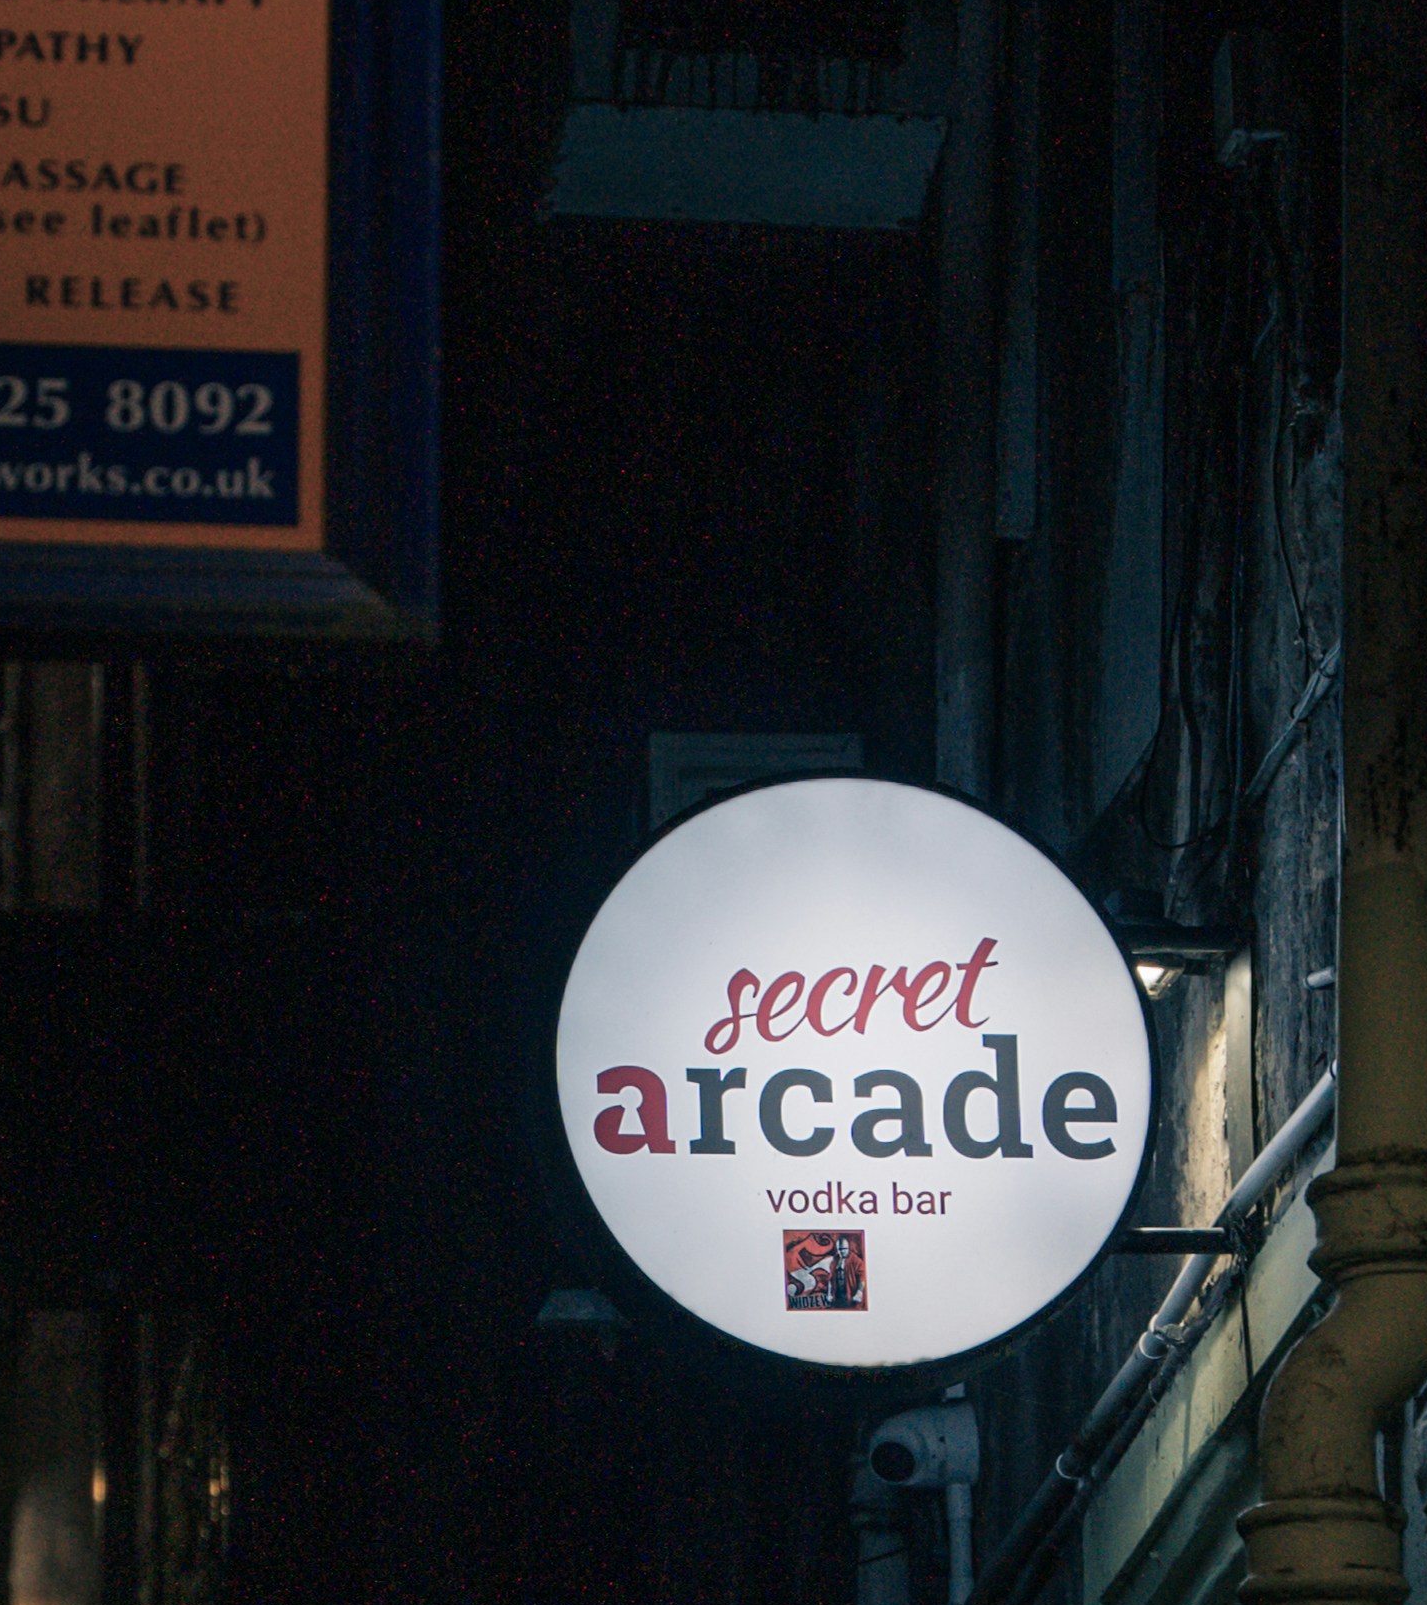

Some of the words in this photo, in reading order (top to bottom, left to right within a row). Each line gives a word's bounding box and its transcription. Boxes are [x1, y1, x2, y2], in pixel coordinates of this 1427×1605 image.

[92, 203, 268, 244] leaflet)
[25, 272, 242, 314] RELEASE
[106, 378, 274, 436] 8092
[703, 936, 999, 1055] secret
[593, 1034, 1118, 1160] arcade
[766, 1180, 878, 1215] vodka
[892, 1181, 952, 1215] bar
